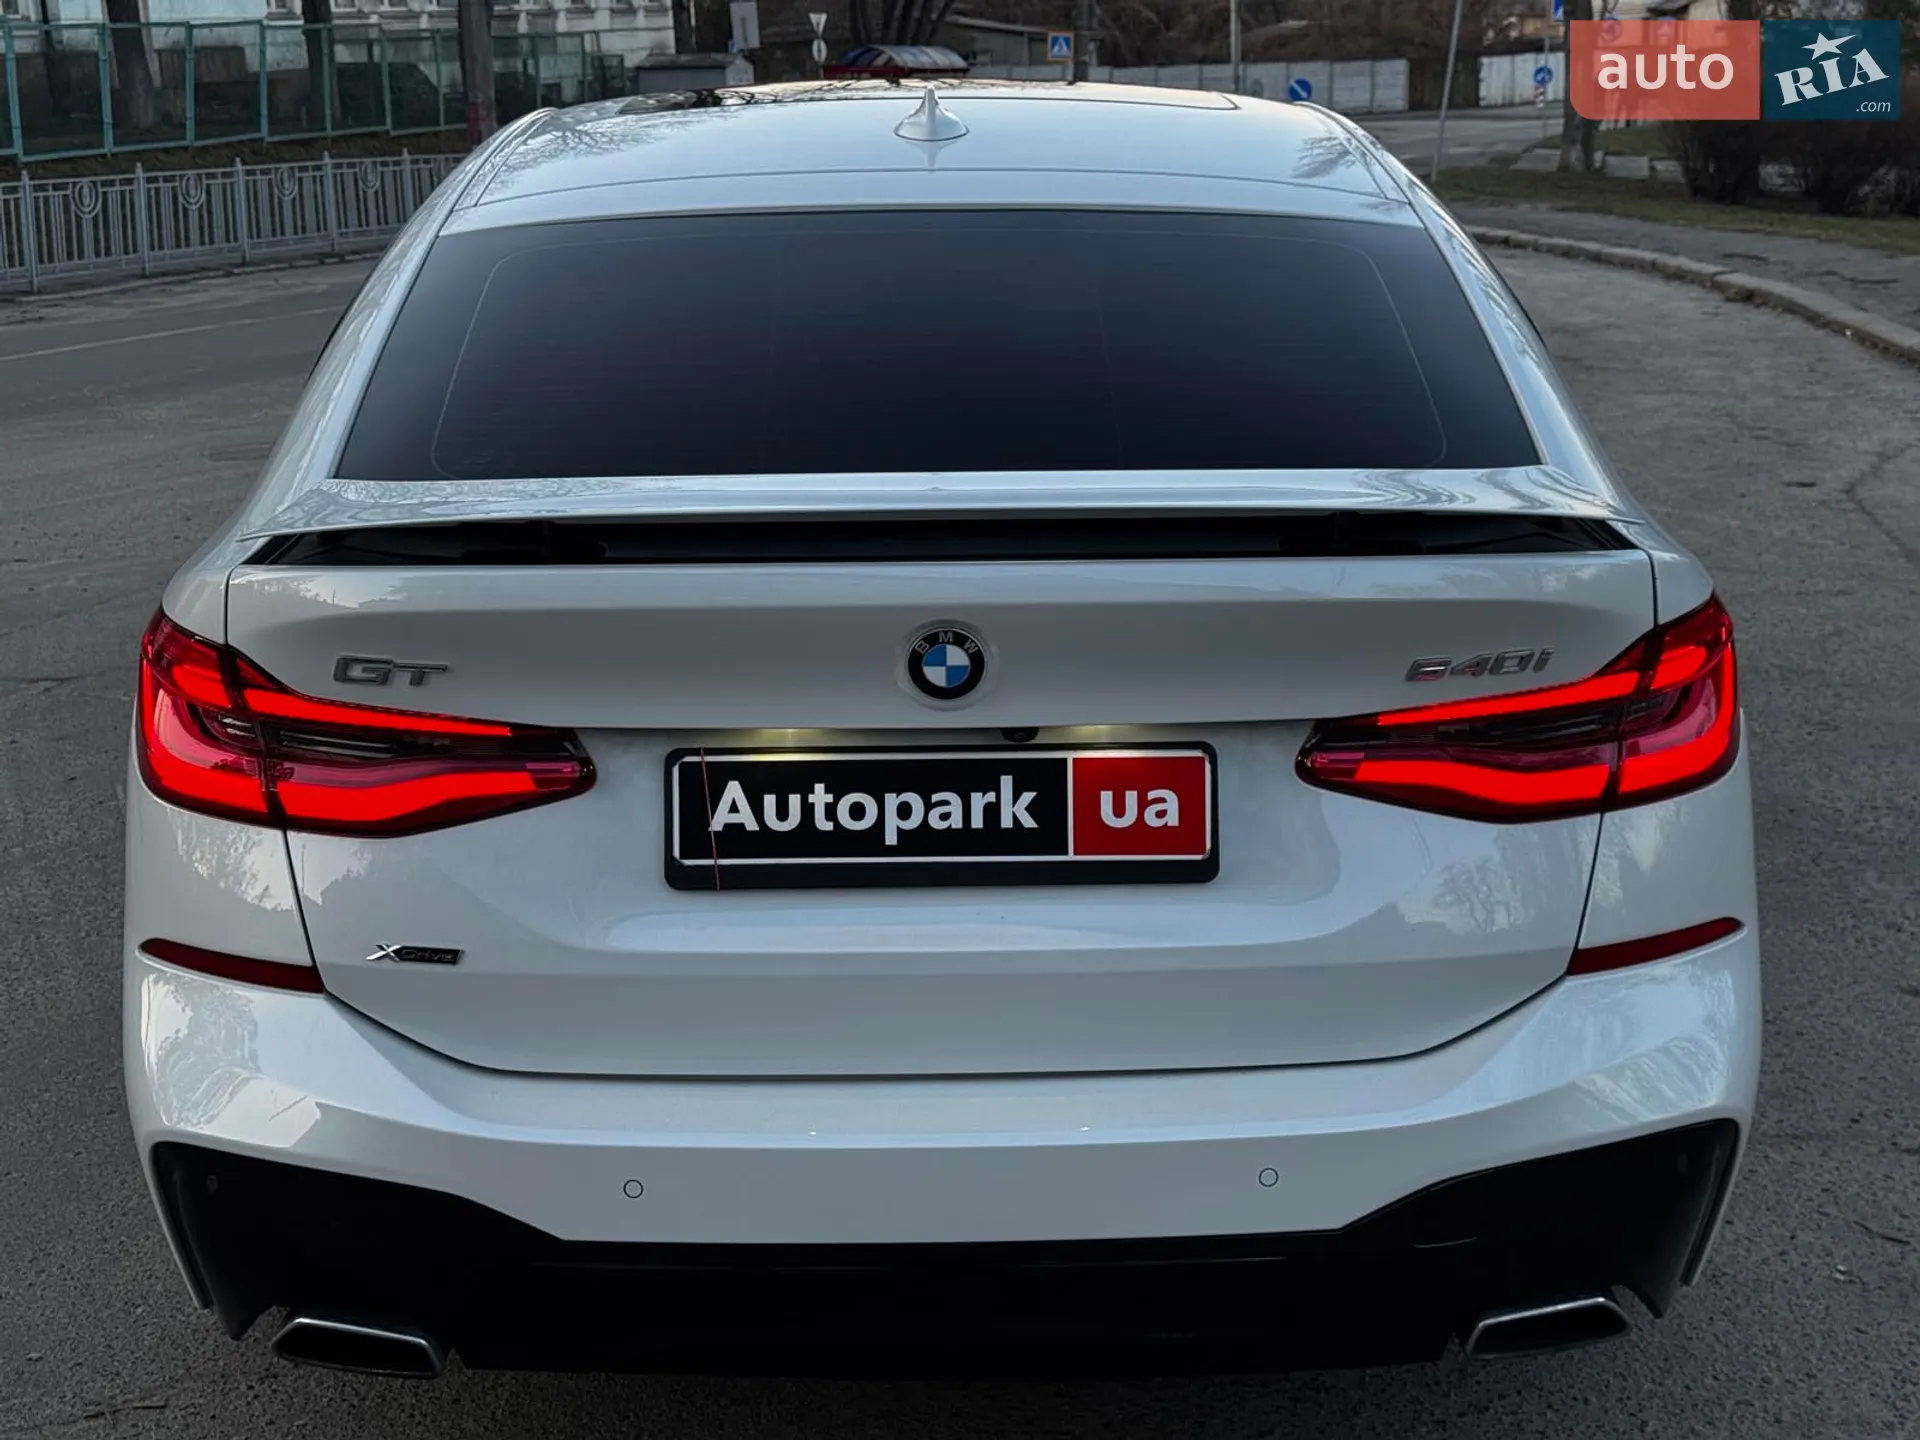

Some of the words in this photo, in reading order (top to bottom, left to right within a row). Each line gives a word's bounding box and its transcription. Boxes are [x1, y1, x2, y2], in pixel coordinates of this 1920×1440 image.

[914, 631, 979, 654] BMW
[333, 653, 448, 686] GT
[1405, 647, 1554, 682] 640i
[708, 775, 1038, 845] Autopark
[1099, 788, 1180, 828] ua
